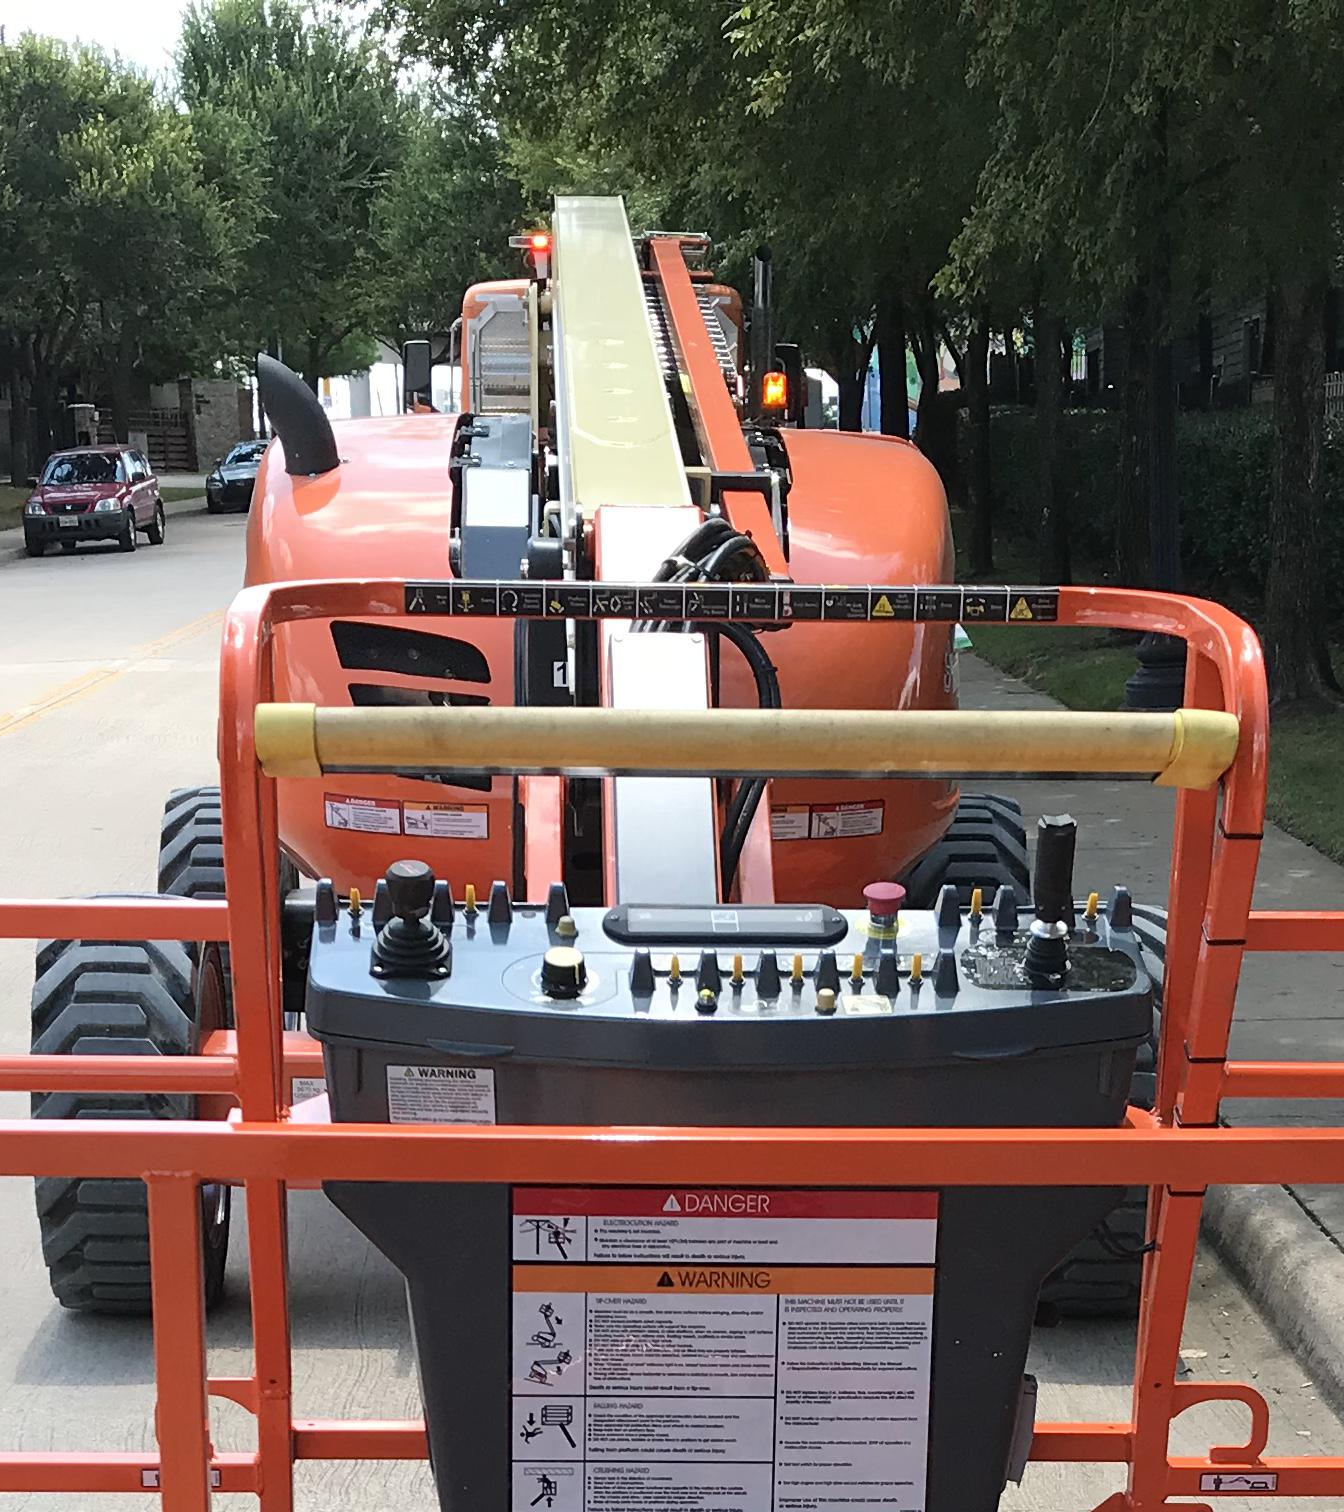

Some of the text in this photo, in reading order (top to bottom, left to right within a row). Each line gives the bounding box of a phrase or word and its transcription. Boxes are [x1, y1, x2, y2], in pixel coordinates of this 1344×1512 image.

[418, 1068, 477, 1079] WARNING
[684, 1194, 770, 1213] DANGER
[678, 1271, 771, 1288] WARNING
